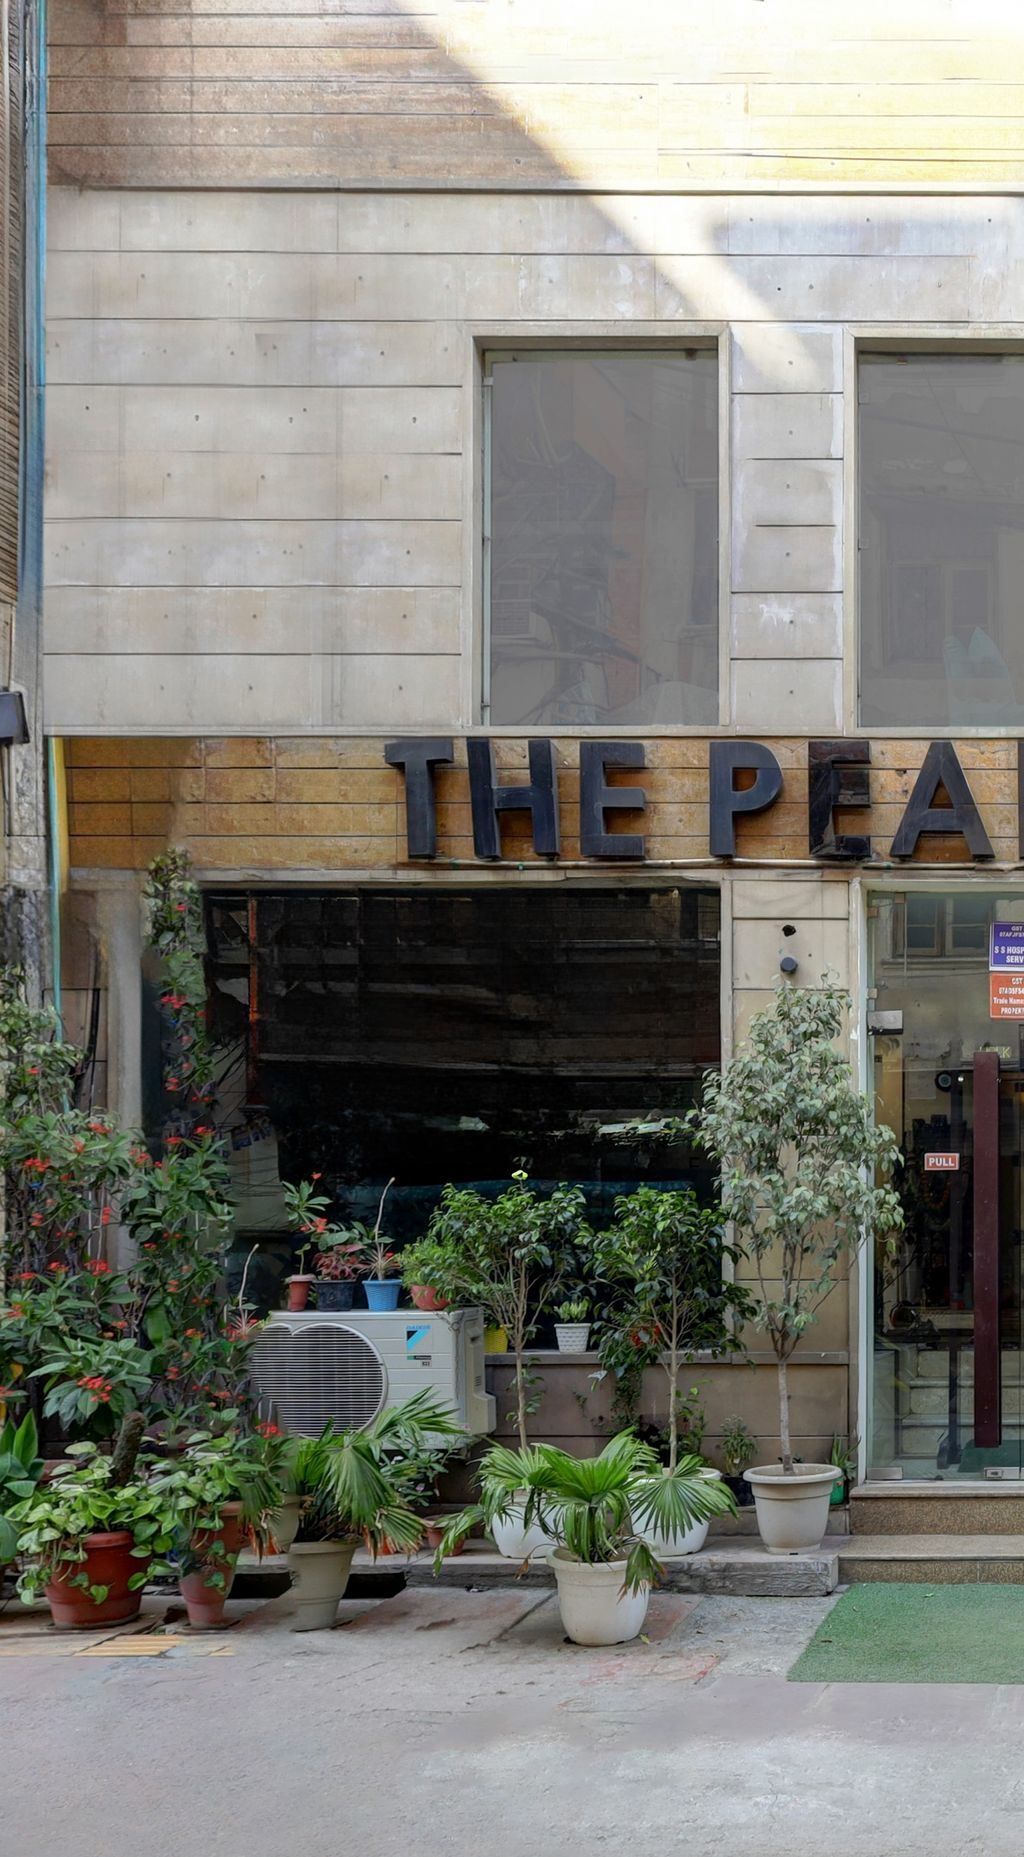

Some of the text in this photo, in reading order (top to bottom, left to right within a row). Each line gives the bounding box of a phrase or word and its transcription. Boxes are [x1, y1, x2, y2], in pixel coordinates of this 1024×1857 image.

[384, 737, 646, 860] THE
[1001, 946, 1006, 954] S
[928, 1157, 955, 1167] PULL
